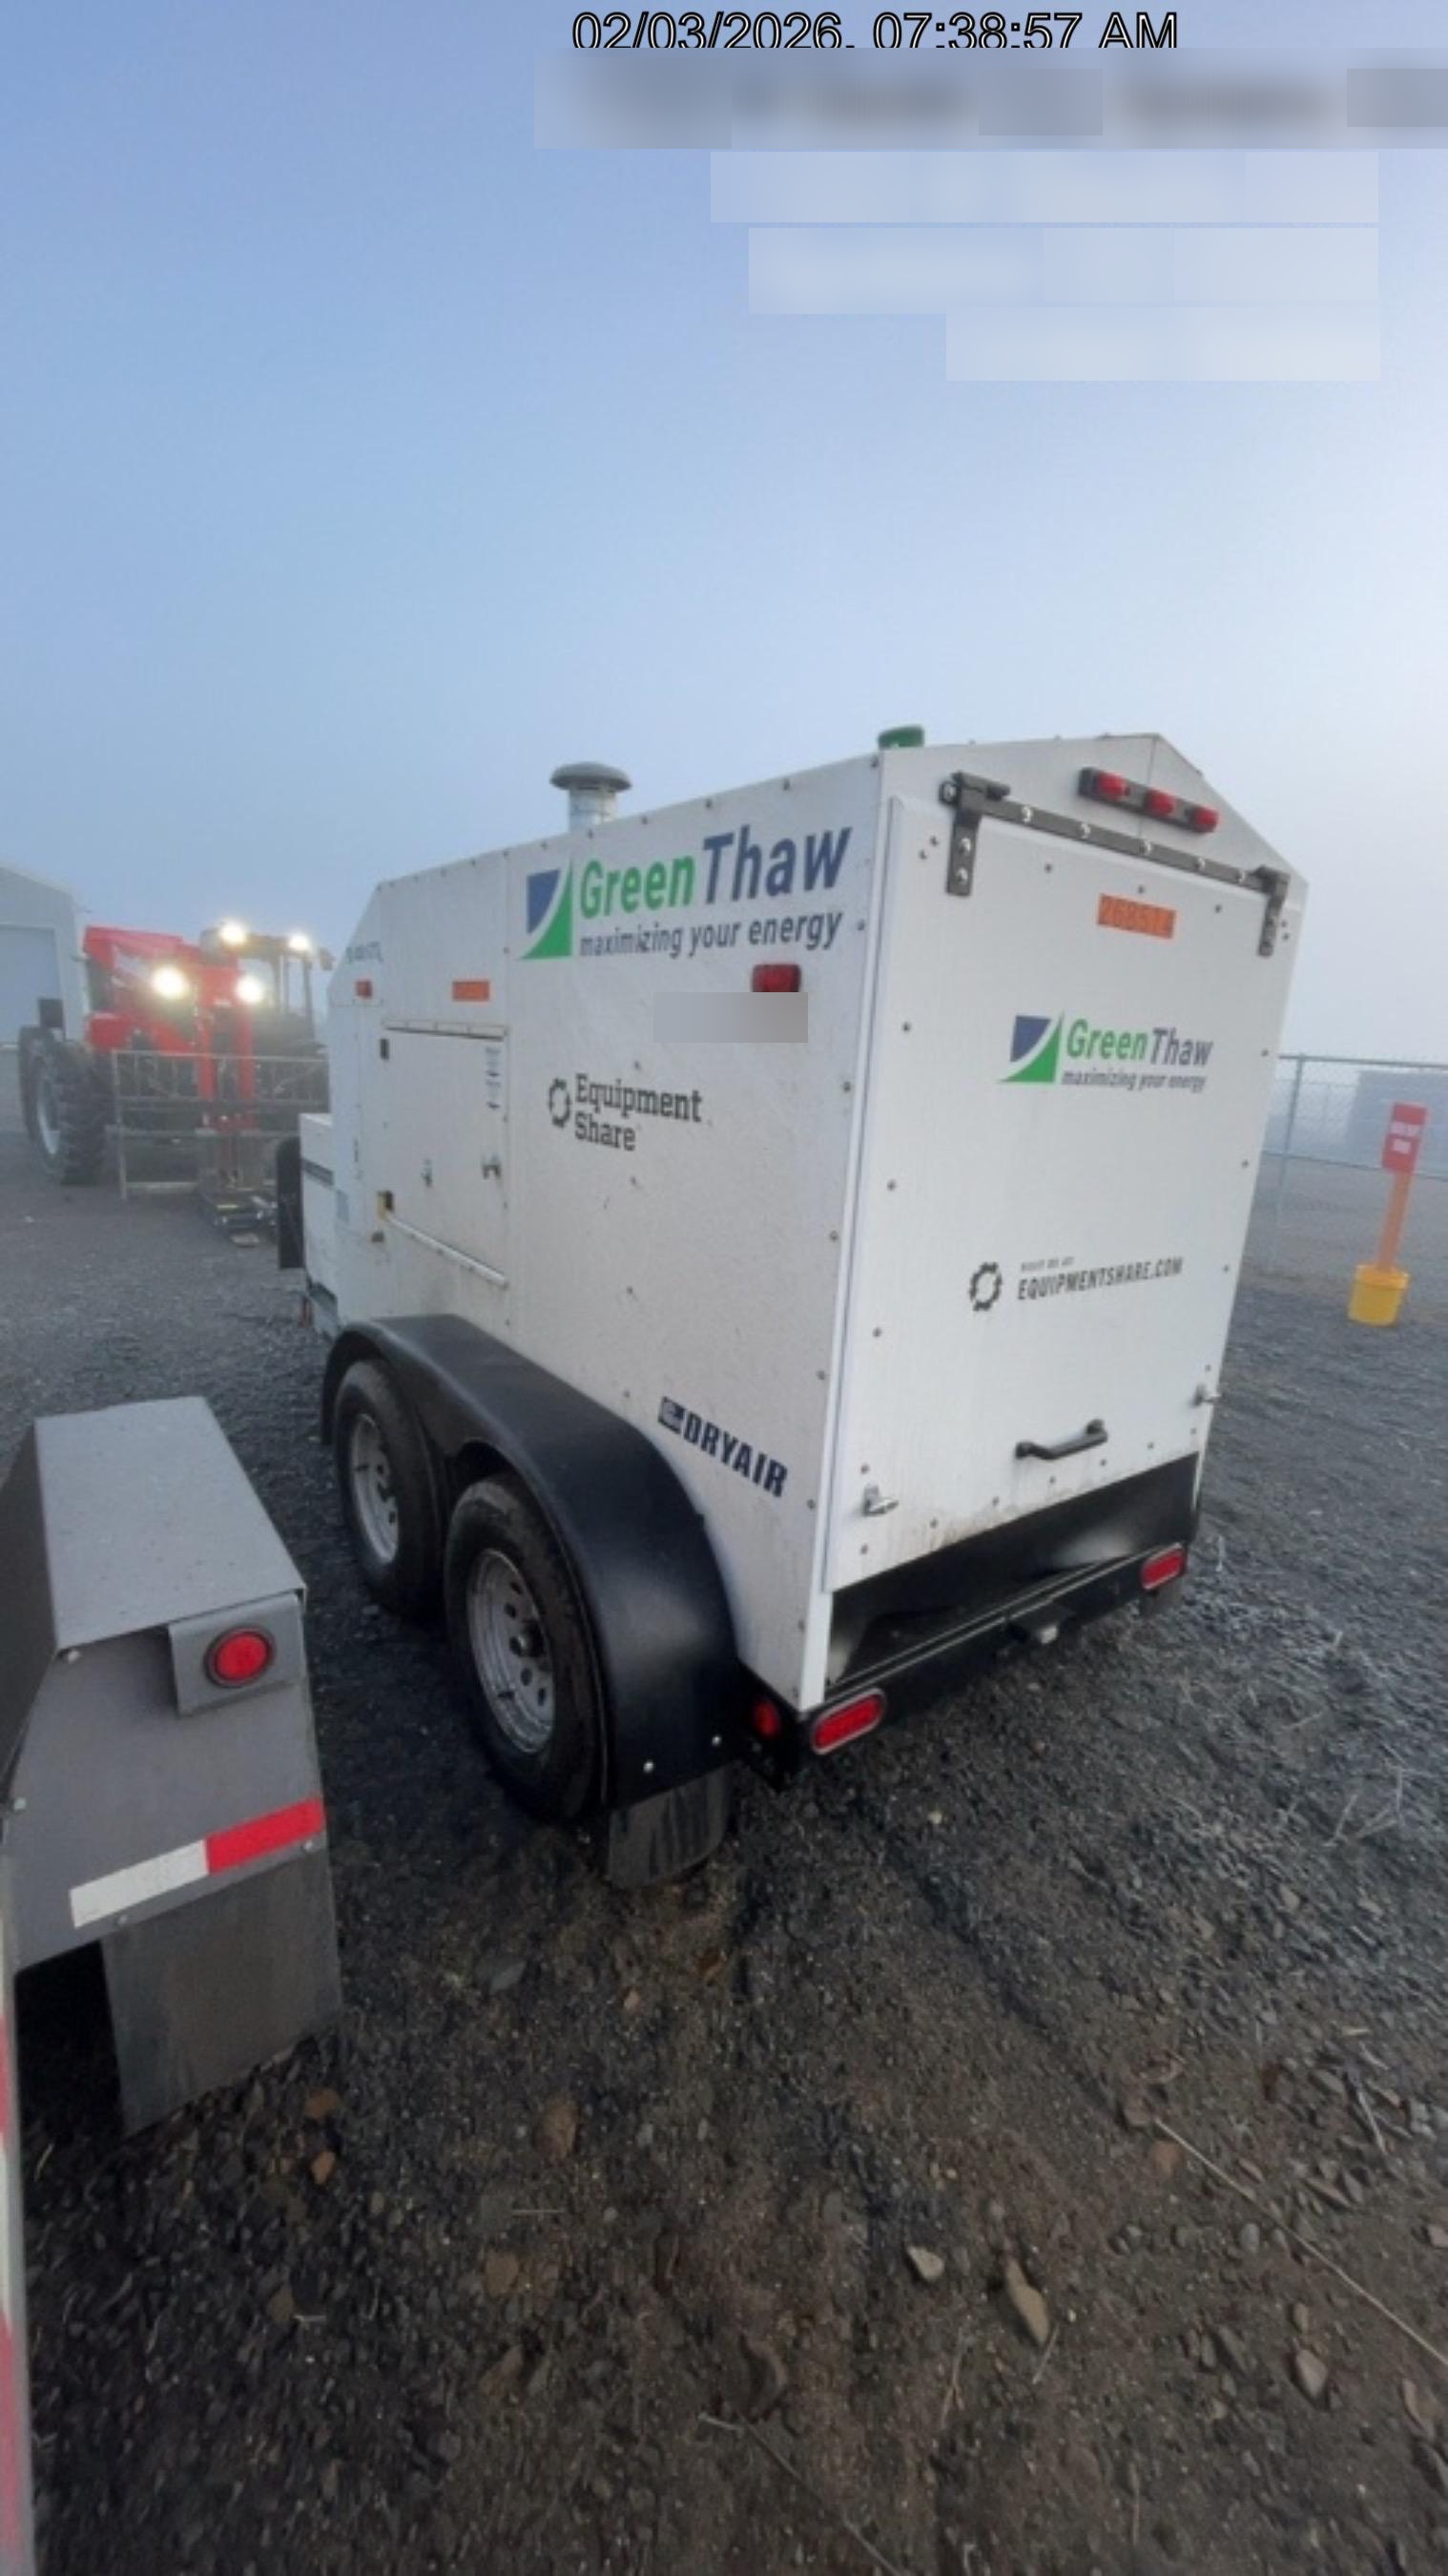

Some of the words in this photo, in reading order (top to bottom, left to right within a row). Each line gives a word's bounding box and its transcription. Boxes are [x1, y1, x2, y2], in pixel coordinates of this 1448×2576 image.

[579, 923, 682, 959] maximizing
[688, 921, 741, 958] your
[748, 911, 842, 951] energy
[575, 1073, 702, 1122] Equipment
[1061, 1068, 1137, 1091] maximizing
[1138, 1073, 1167, 1091] your
[1169, 1074, 1207, 1093] energy
[575, 1111, 636, 1152] Share
[1017, 1257, 1183, 1300] EQUIPMENTSHARE.COM
[683, 1411, 788, 1498] DRYAIR
